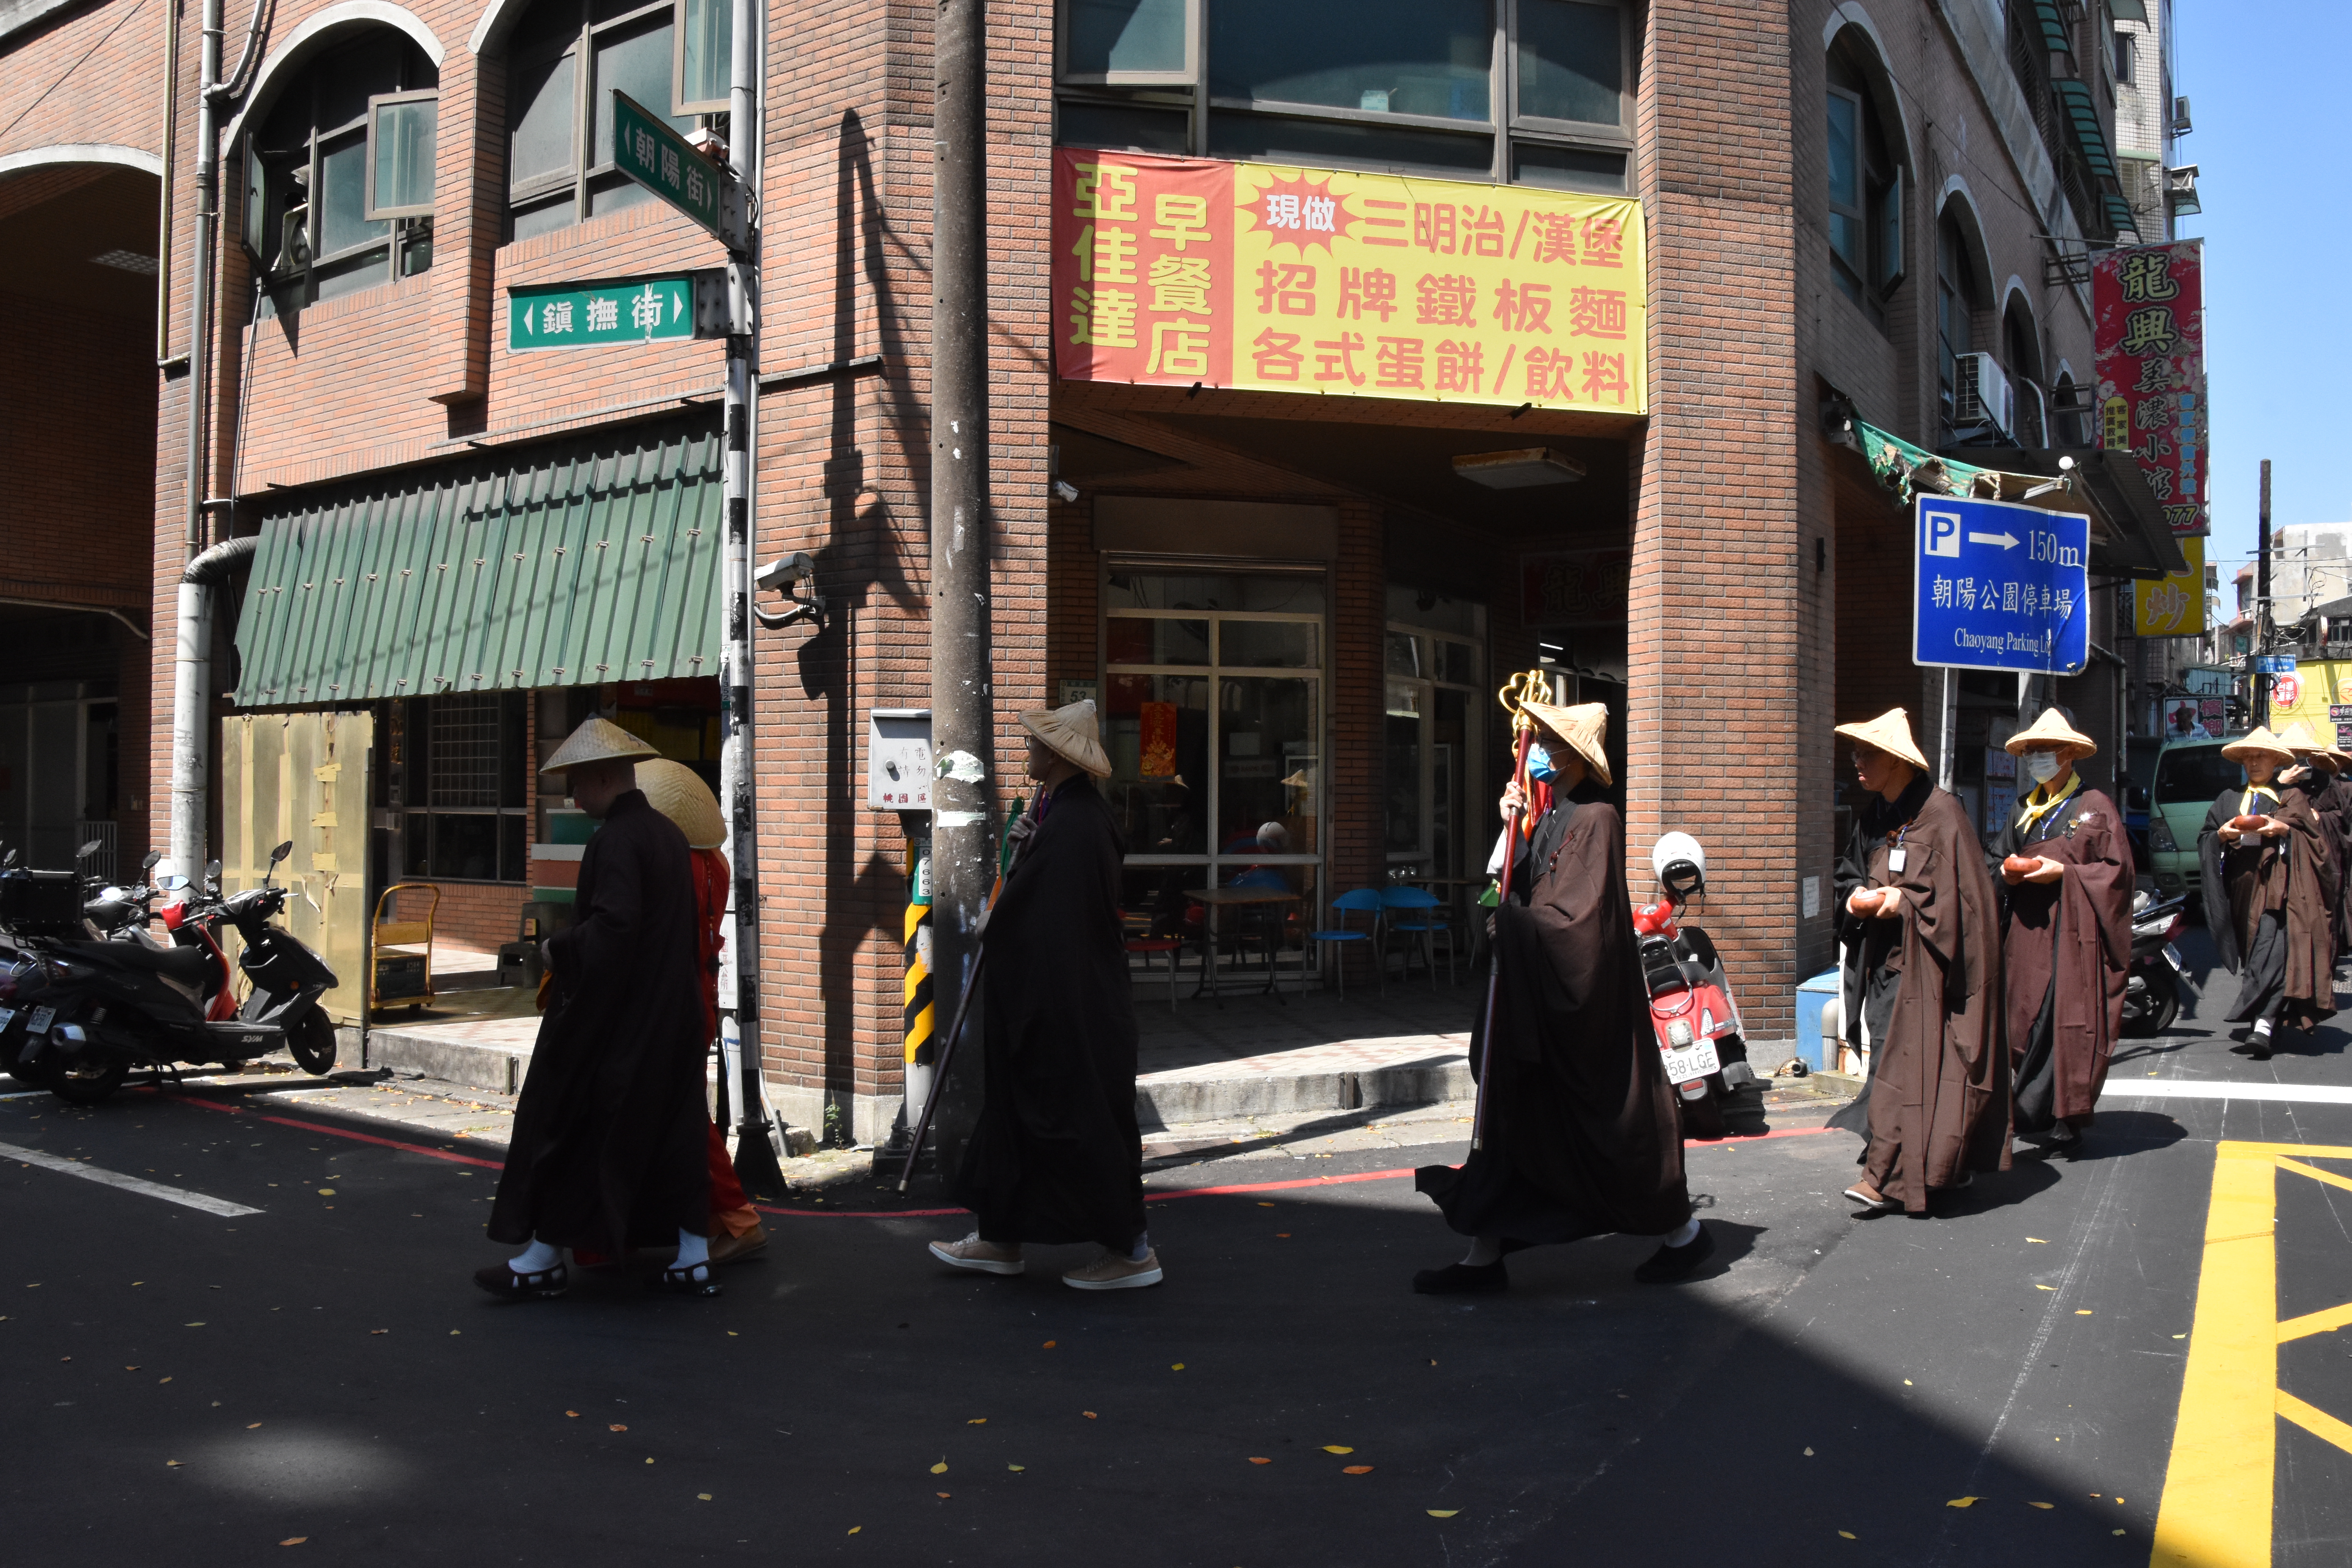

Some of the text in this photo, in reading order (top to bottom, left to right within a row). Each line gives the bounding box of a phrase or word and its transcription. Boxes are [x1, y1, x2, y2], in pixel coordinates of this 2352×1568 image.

[636, 127, 703, 207] 朝陽街
[1266, 194, 1336, 232] 現做
[1361, 198, 1624, 269] 三明治/漢堡
[1069, 162, 1139, 348] 亞佳達
[1145, 193, 1212, 376] 早餐店
[1255, 260, 1627, 340] 招牌鐵板麵
[1252, 326, 1630, 405] 各式蛋餅/飲料
[1930, 516, 1955, 551] P
[1931, 574, 2073, 620] 朝陽公園停車場
[1954, 628, 2004, 654] Chaoyang
[2006, 632, 2038, 657] Parking
[241, 1035, 264, 1043] SYM
